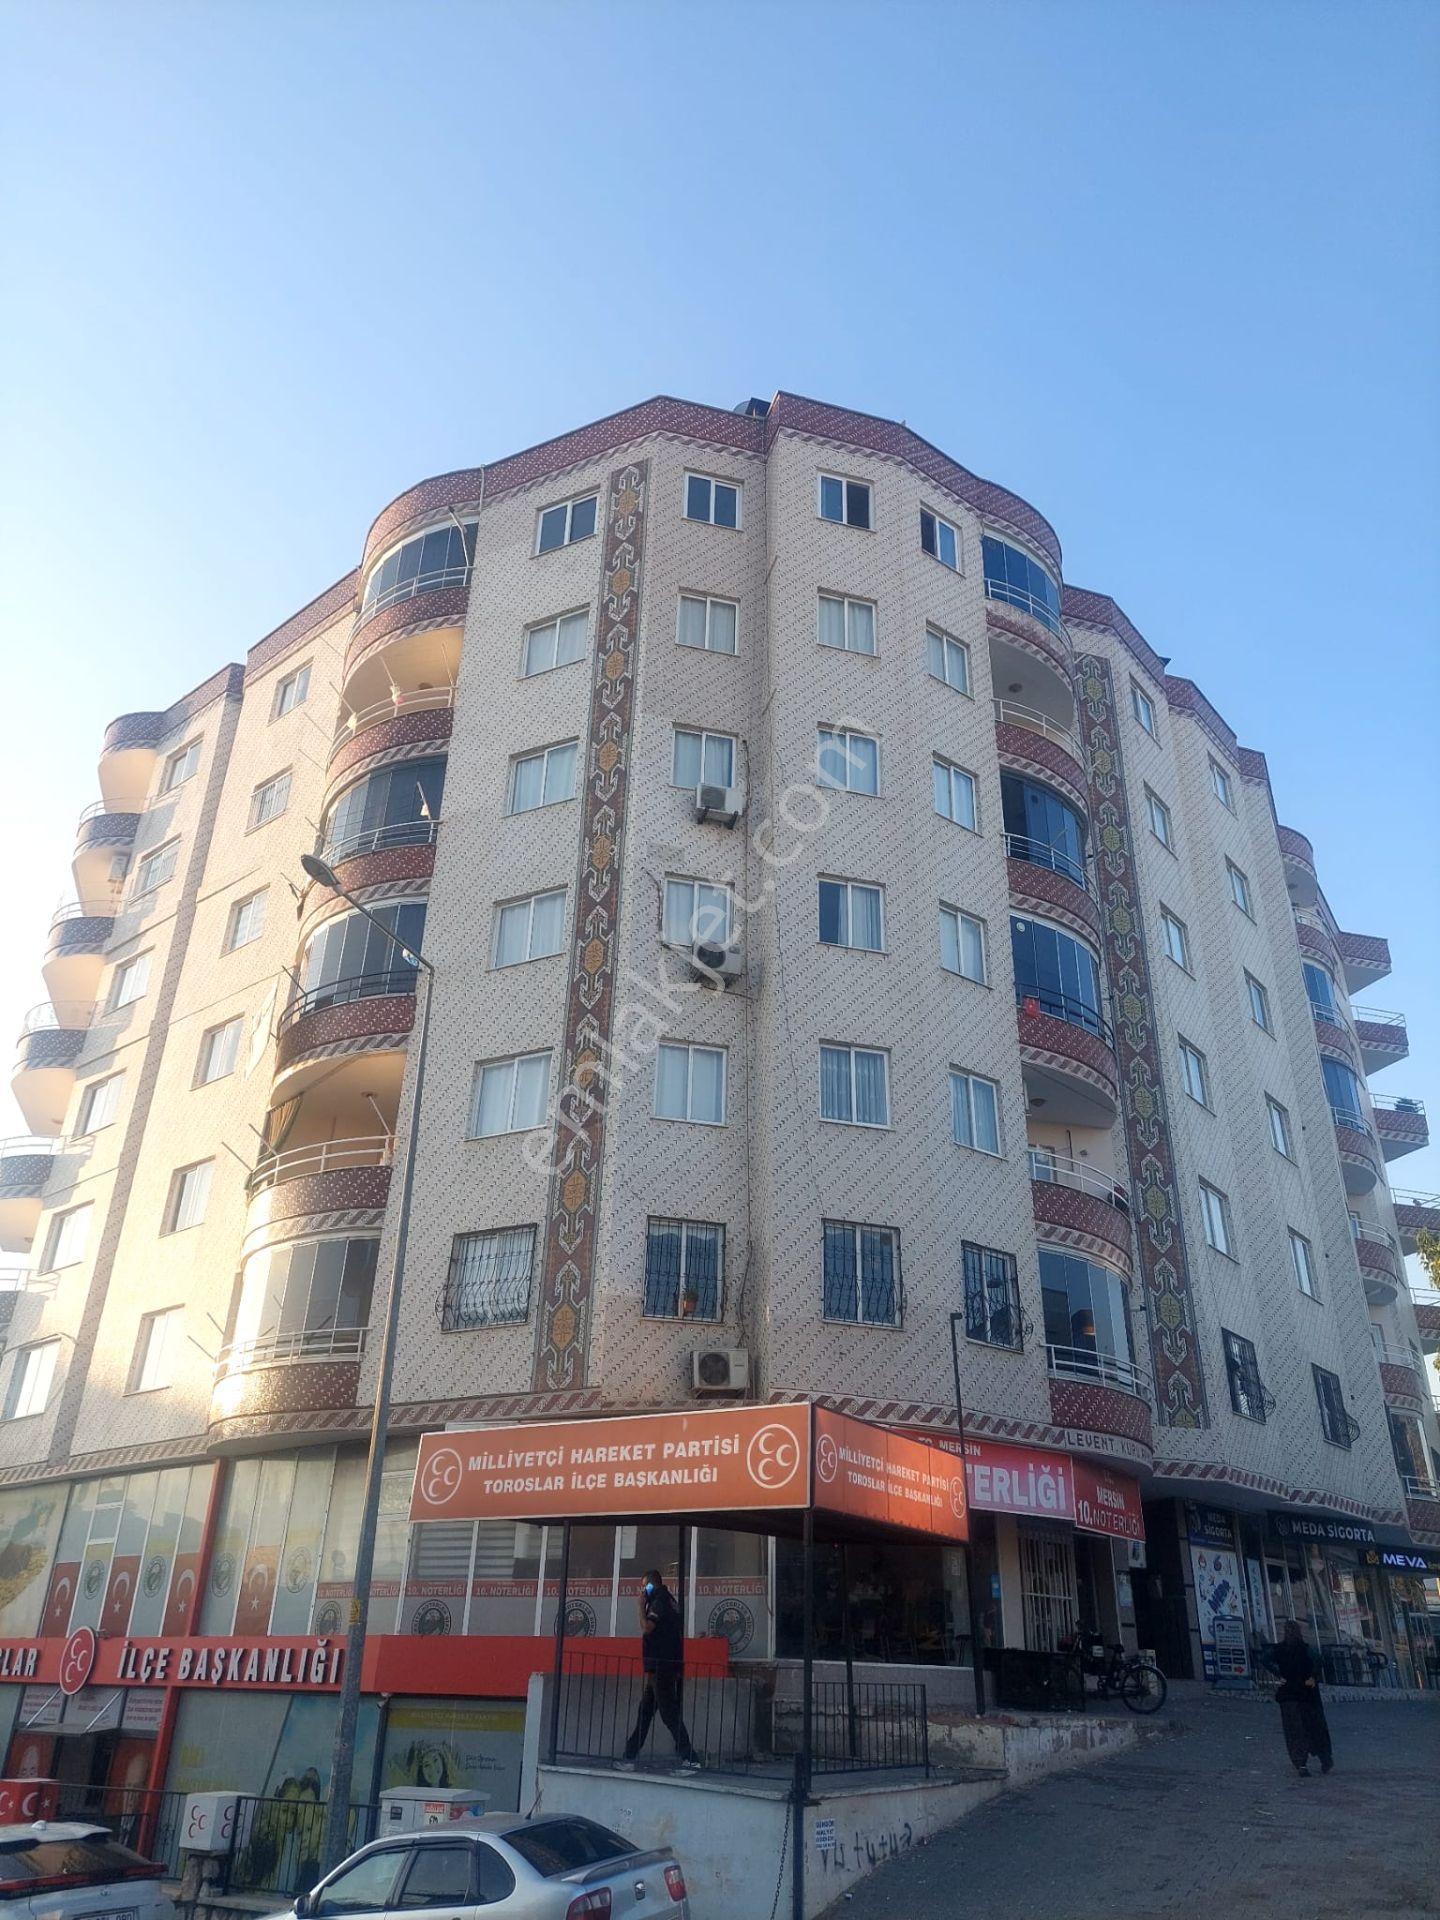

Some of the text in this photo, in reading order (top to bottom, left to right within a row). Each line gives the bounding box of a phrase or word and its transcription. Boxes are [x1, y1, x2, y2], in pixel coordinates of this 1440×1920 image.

[468, 1434, 740, 1471] MİLLİYETÇİ HAREKET PARTİSİ
[939, 1438, 982, 1456] MERSİN
[484, 1464, 718, 1494] TOROSLAR İLÇE BAŞKANLIĞI
[839, 1446, 949, 1491] MİLLİYETÇİ HAREKET PARTİSİ
[848, 1471, 886, 1491] TOROSLAR
[887, 1480, 903, 1497] İLÇE
[1292, 1521, 1375, 1542] MEDA SİGORTA
[1383, 1553, 1427, 1568] MEVA
[566, 1584, 609, 1596] OTERLİĞİ
[0, 1638, 341, 1684] LAR İLÇE BAŞKANLIĞI
